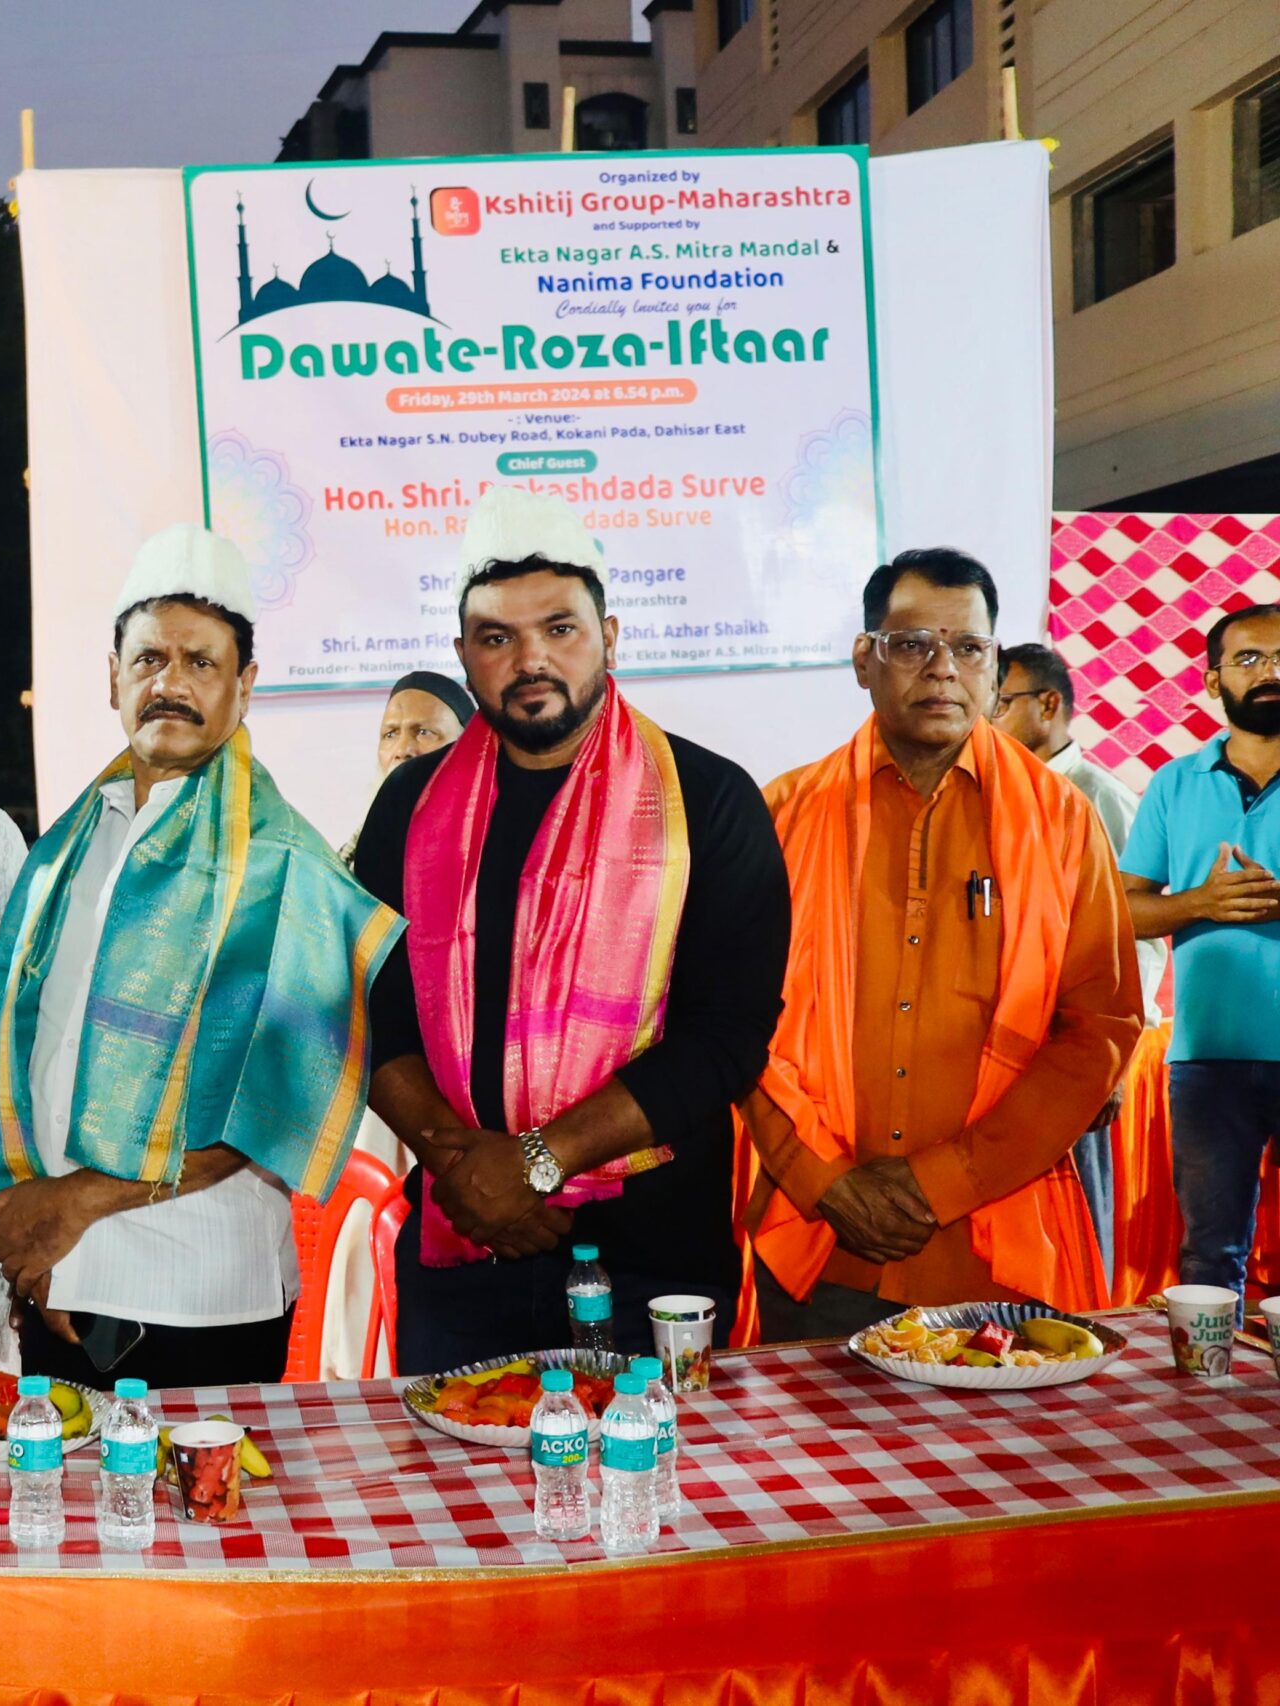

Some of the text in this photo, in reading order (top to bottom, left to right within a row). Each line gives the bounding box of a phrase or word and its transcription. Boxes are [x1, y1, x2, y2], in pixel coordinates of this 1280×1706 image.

[599, 170, 700, 186] Organized by
[485, 186, 852, 217] Kshitij Group-Maharashtra
[593, 219, 700, 232] and Supported by
[500, 239, 839, 265] Ekta Nagar A.S. Mitra Mandal &
[537, 267, 784, 293] Nanima Foundation
[555, 297, 738, 319] Cordially Invites you for
[239, 318, 830, 380] Dawate-Roza-Iftaar
[398, 386, 685, 408] Friday, 29th March 2024 at 6.54 p.m.
[339, 422, 746, 449] Ekta Nagar S.N. Dubey Road, Kokani Pada, Dahisar East
[508, 456, 587, 470] Chief Guest
[324, 486, 394, 511] Hon.
[401, 479, 471, 509] Shri.
[681, 472, 765, 498] Surve
[384, 517, 438, 537] Hon.
[646, 507, 712, 527] Surve
[608, 567, 686, 586] Pangare
[322, 635, 360, 653] Shri.
[365, 637, 420, 651] Arman
[623, 623, 659, 640] Shri.
[664, 622, 710, 638] Azhar
[714, 619, 769, 636] Shaikh
[288, 663, 354, 676] Founder-
[359, 660, 414, 673] Nanima
[636, 649, 667, 661] Ekta
[670, 647, 712, 661] Nagar
[743, 644, 778, 656] Mitra
[782, 641, 832, 654] Mandal
[540, 1436, 585, 1454] ACKO
